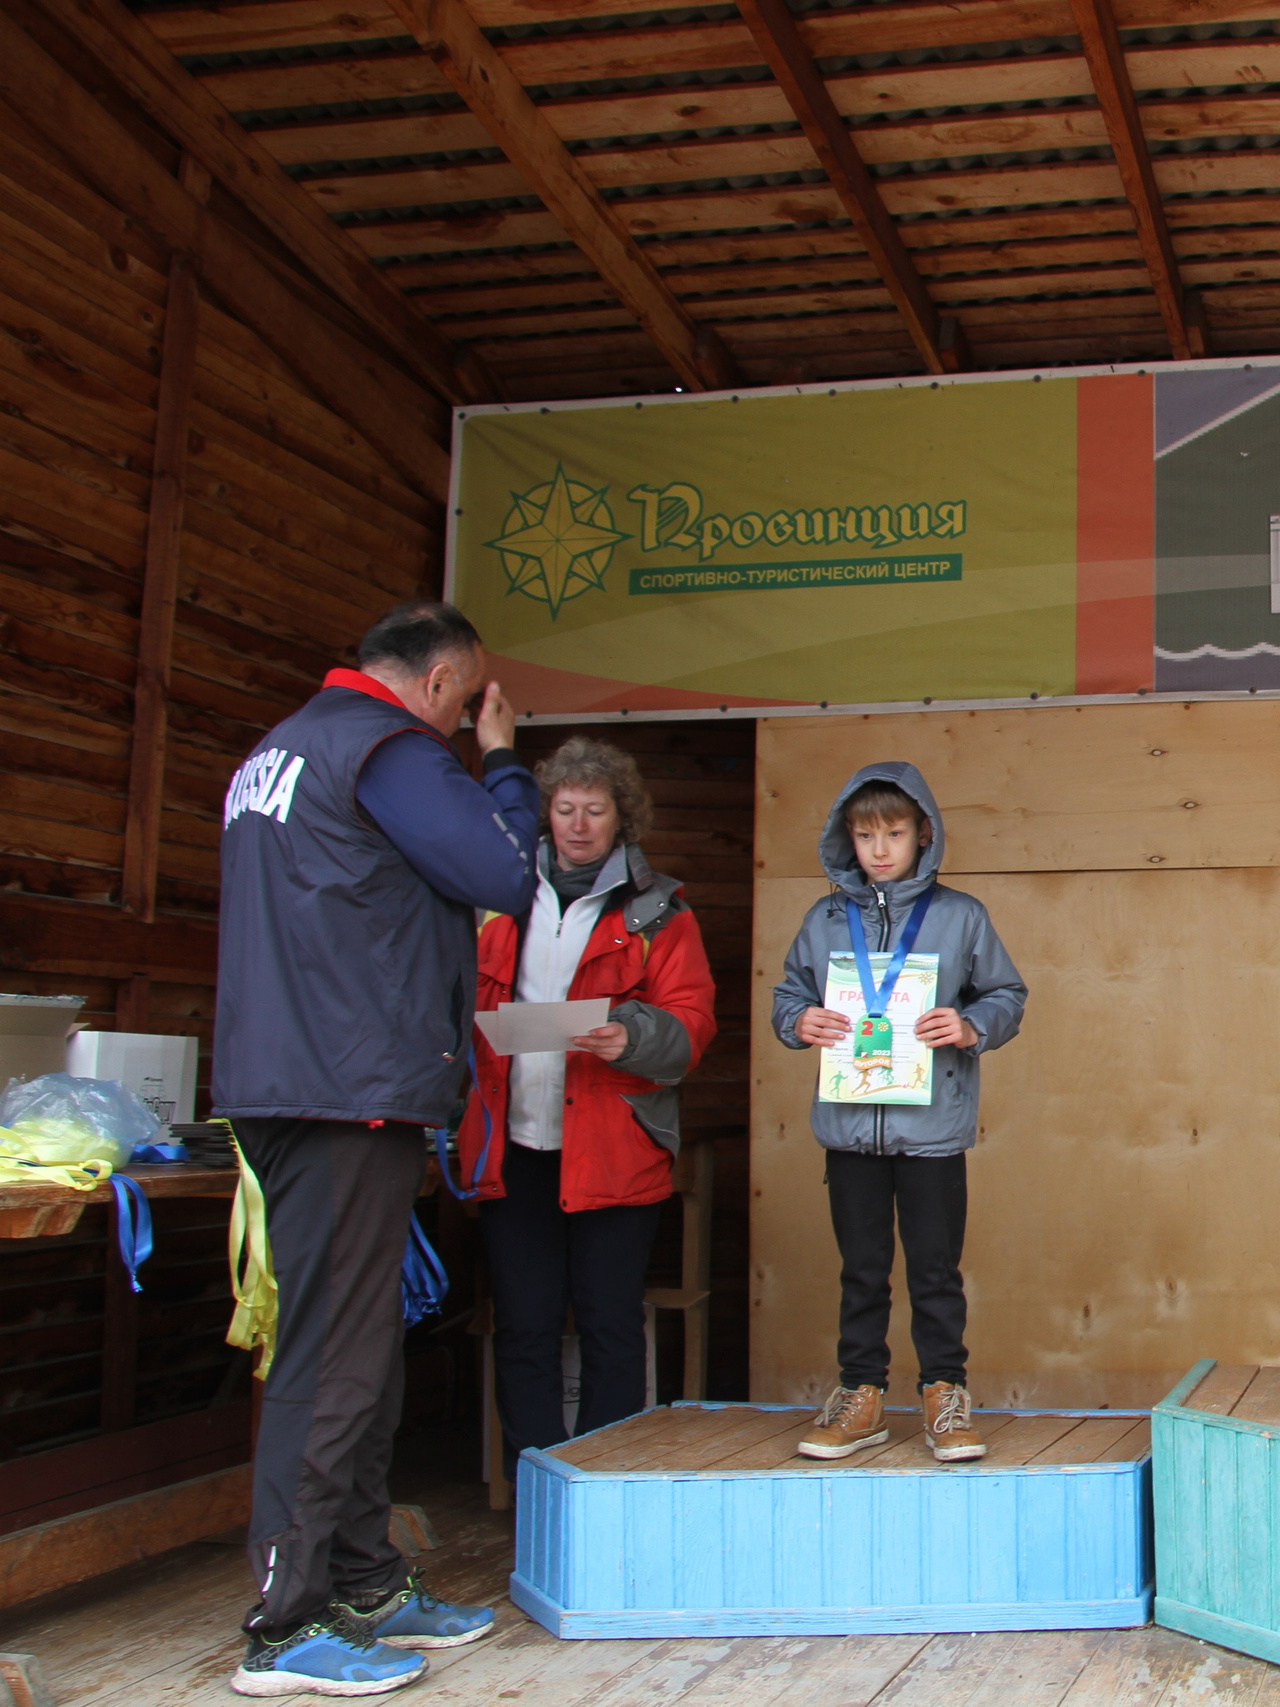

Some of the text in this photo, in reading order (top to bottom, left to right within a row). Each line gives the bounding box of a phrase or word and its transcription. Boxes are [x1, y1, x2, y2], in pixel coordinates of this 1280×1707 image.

[626, 481, 967, 562] Провинция
[639, 560, 950, 588] СПОРТИВНО-ТУРИСТИЧЕСКИЙ ЦЕНТР
[861, 1020, 873, 1036] 2
